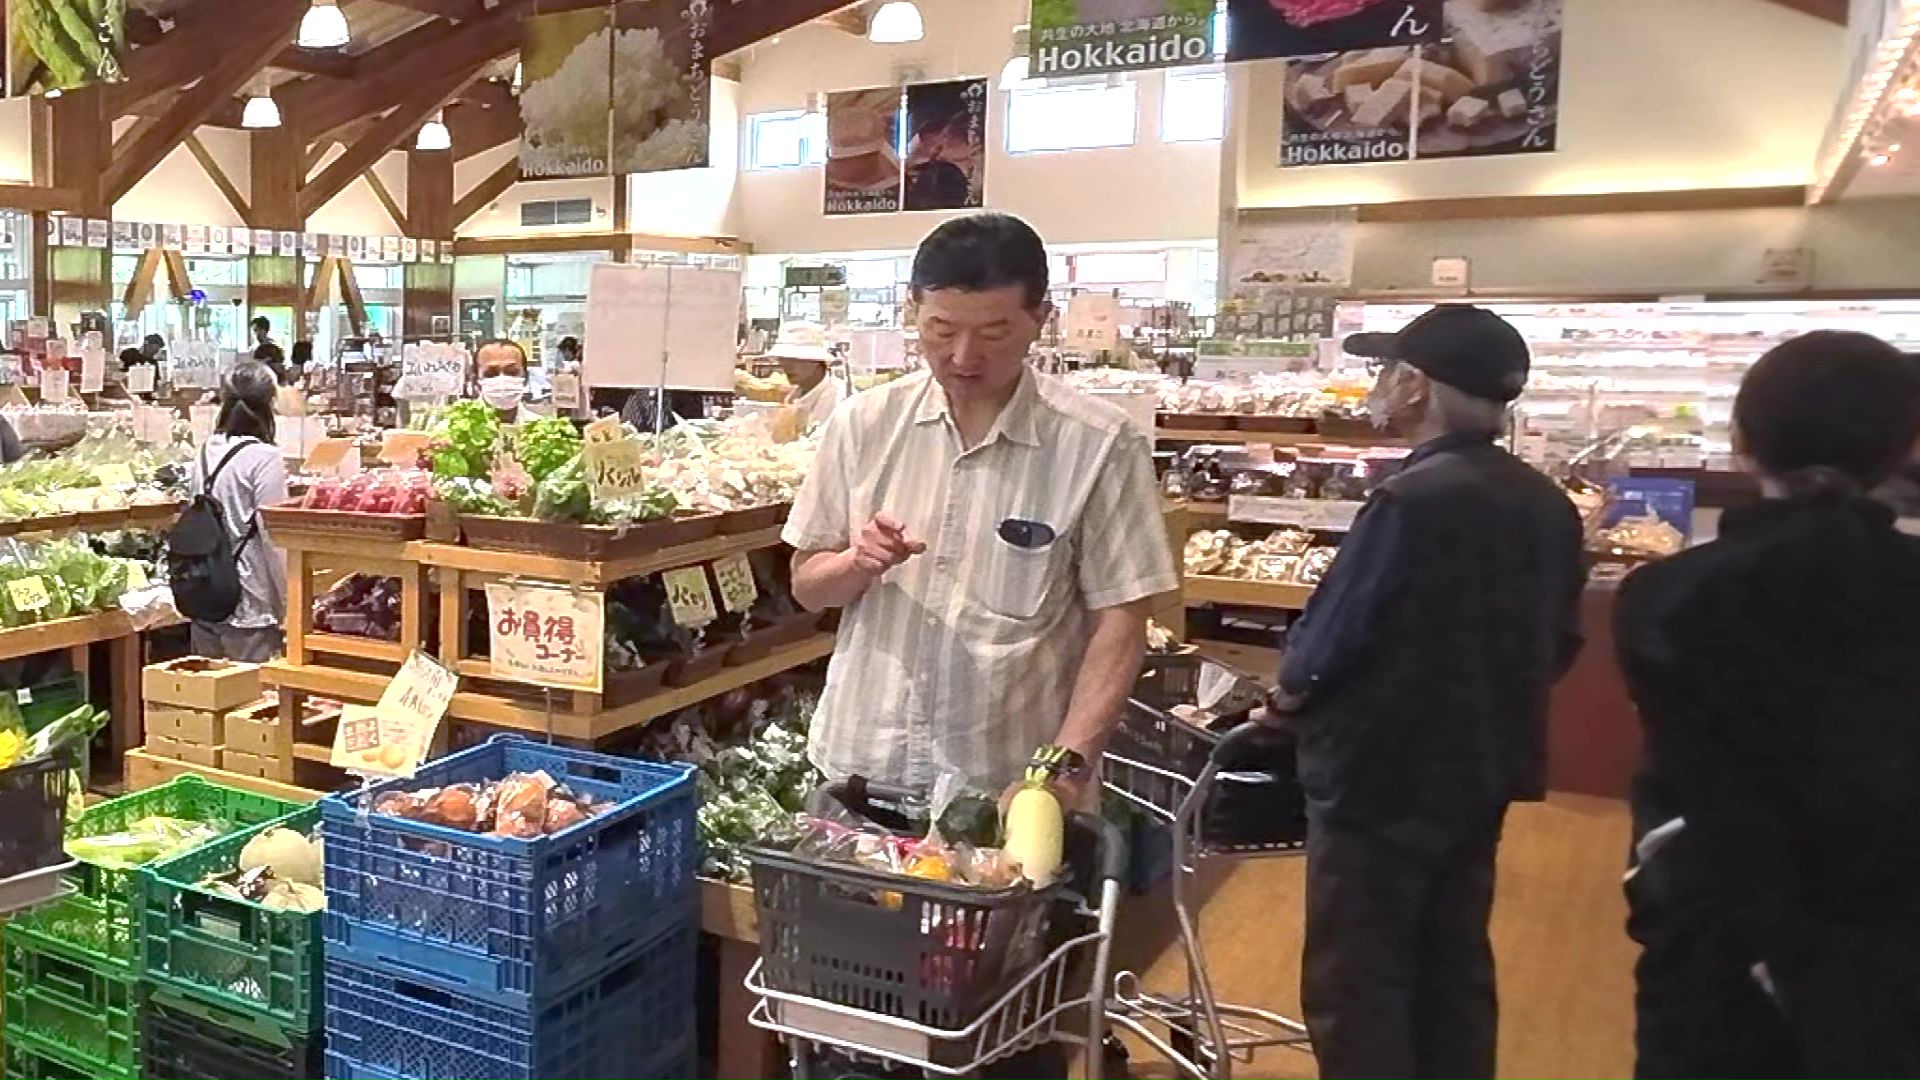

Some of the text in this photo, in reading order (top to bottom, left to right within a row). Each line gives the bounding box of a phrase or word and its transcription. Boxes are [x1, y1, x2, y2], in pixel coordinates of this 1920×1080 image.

[1389, 5, 1430, 38] ん
[1037, 33, 1206, 73] Hokkaido
[1287, 140, 1404, 162] Hokkaido
[523, 157, 604, 177] Hokkaido
[826, 197, 897, 212] Hokkaido
[535, 644, 586, 663] コーナー
